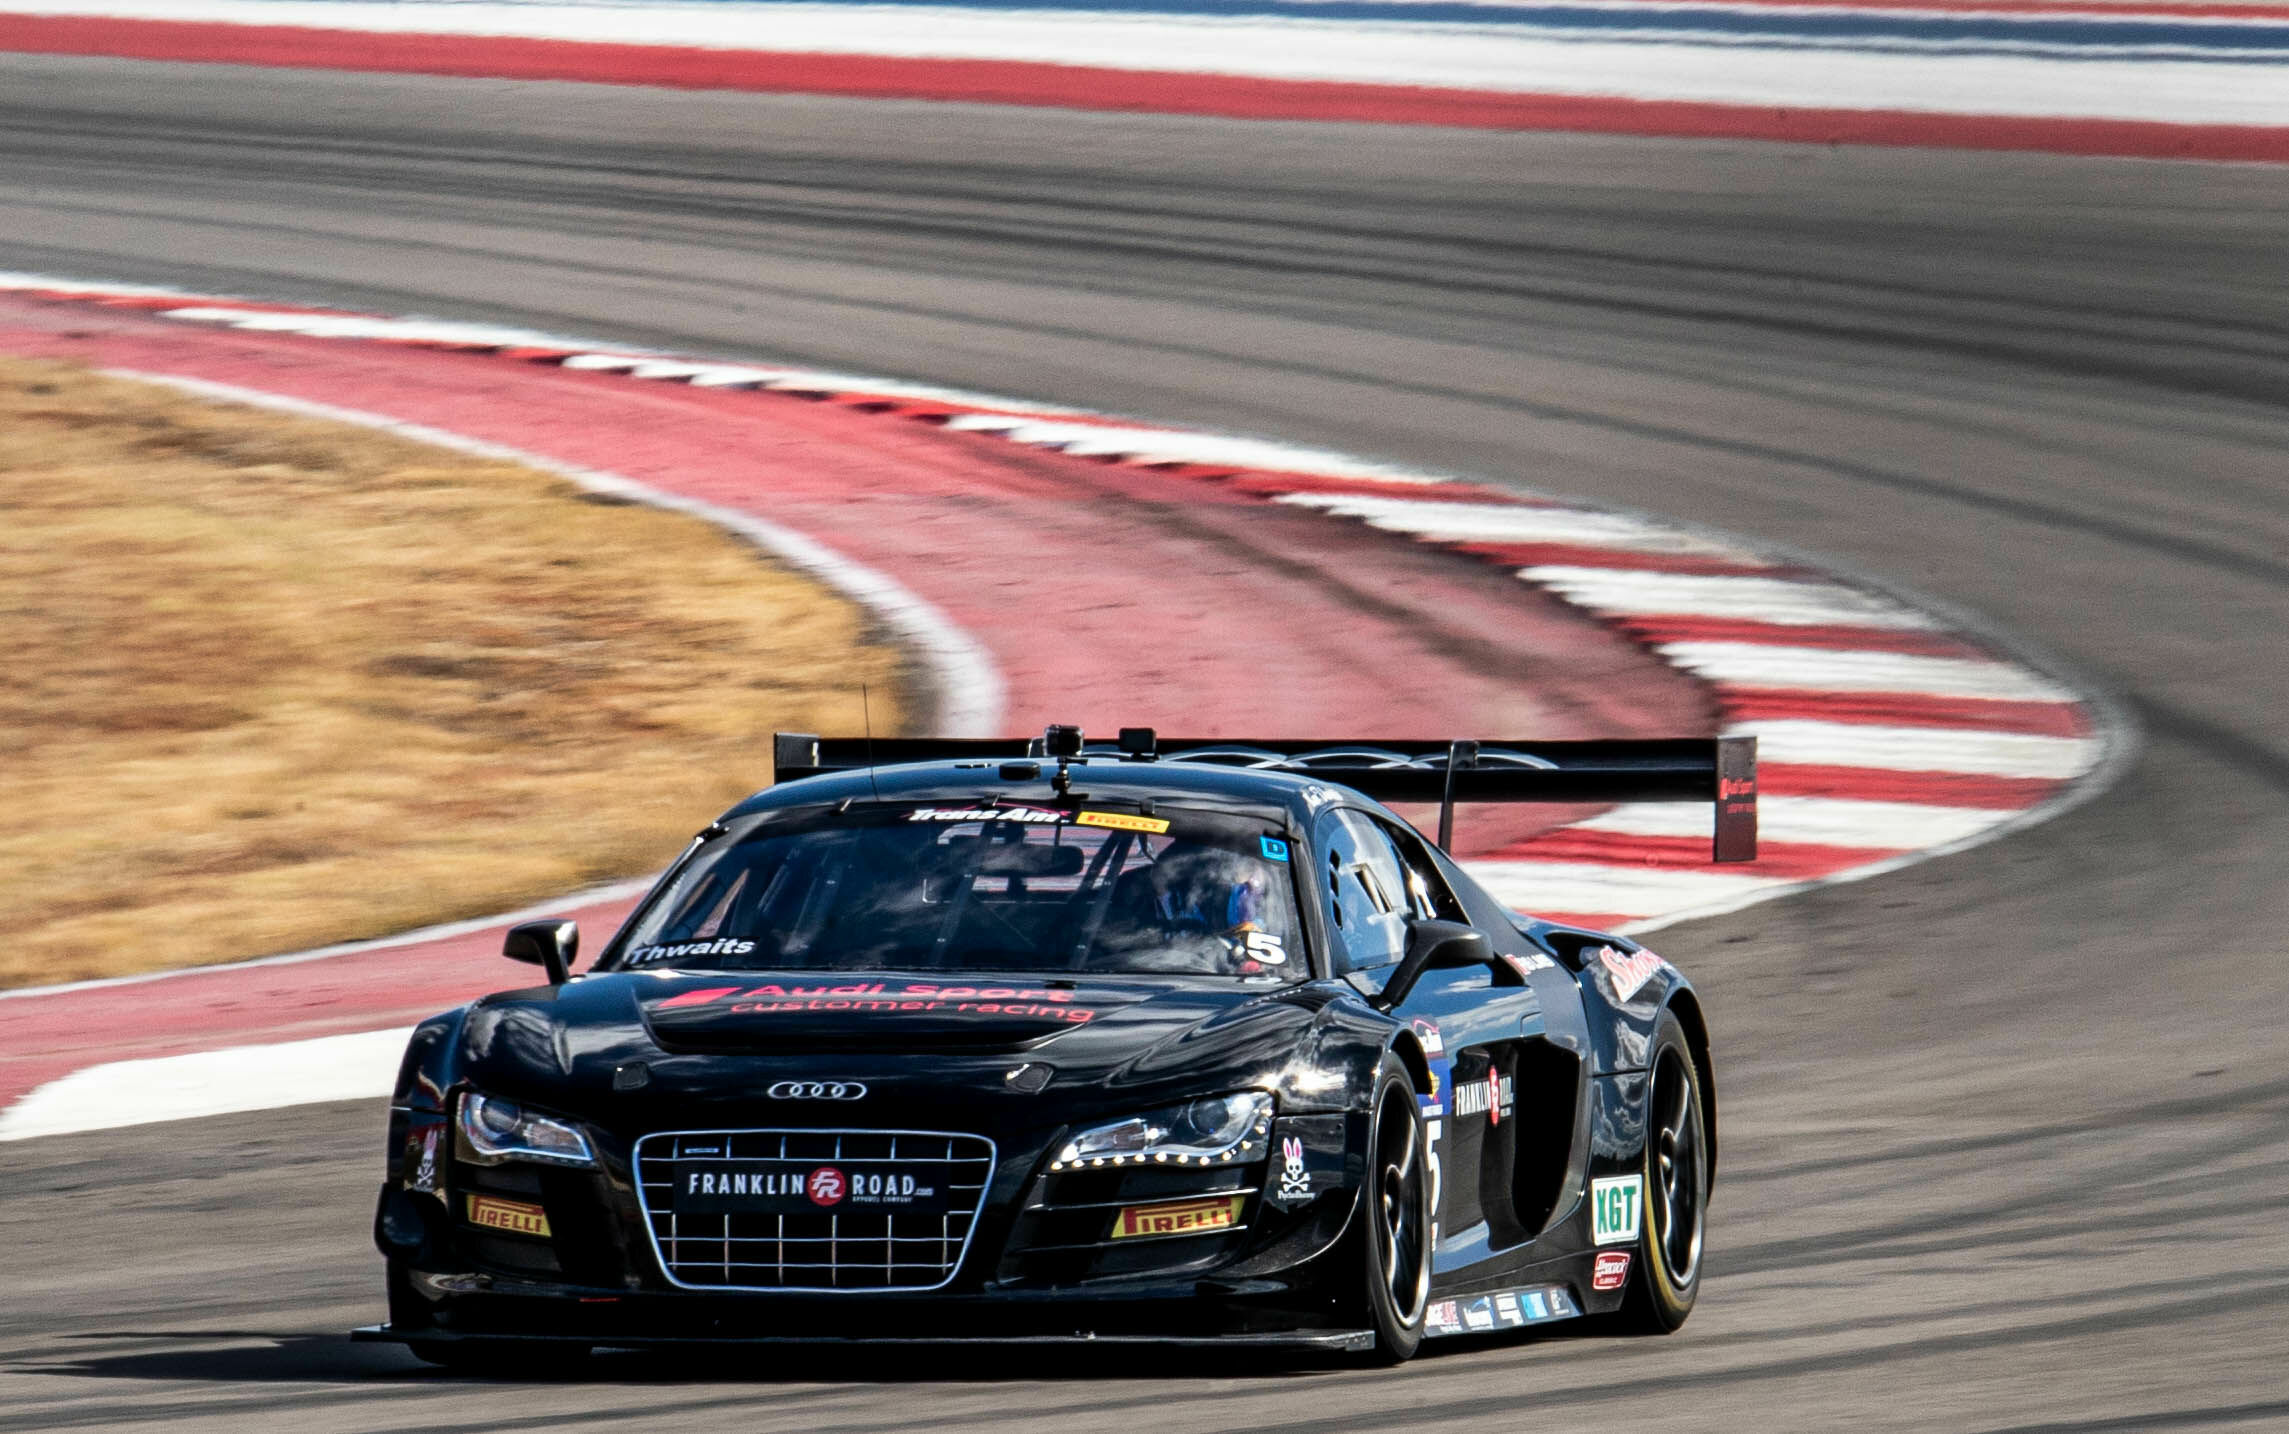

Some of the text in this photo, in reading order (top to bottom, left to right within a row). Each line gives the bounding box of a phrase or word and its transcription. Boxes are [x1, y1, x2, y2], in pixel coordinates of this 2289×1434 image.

[908, 808, 1000, 821] Trans
[630, 938, 755, 964] Thwaits
[1246, 931, 1287, 965] 5
[741, 983, 1075, 1002] Audi Sport
[730, 999, 1096, 1023] customer racing
[688, 1173, 805, 1195] FRANKLIN
[471, 1195, 545, 1233] PIRELLI
[1123, 1196, 1232, 1235] PIRELLI
[1596, 1185, 1637, 1234] XGT
